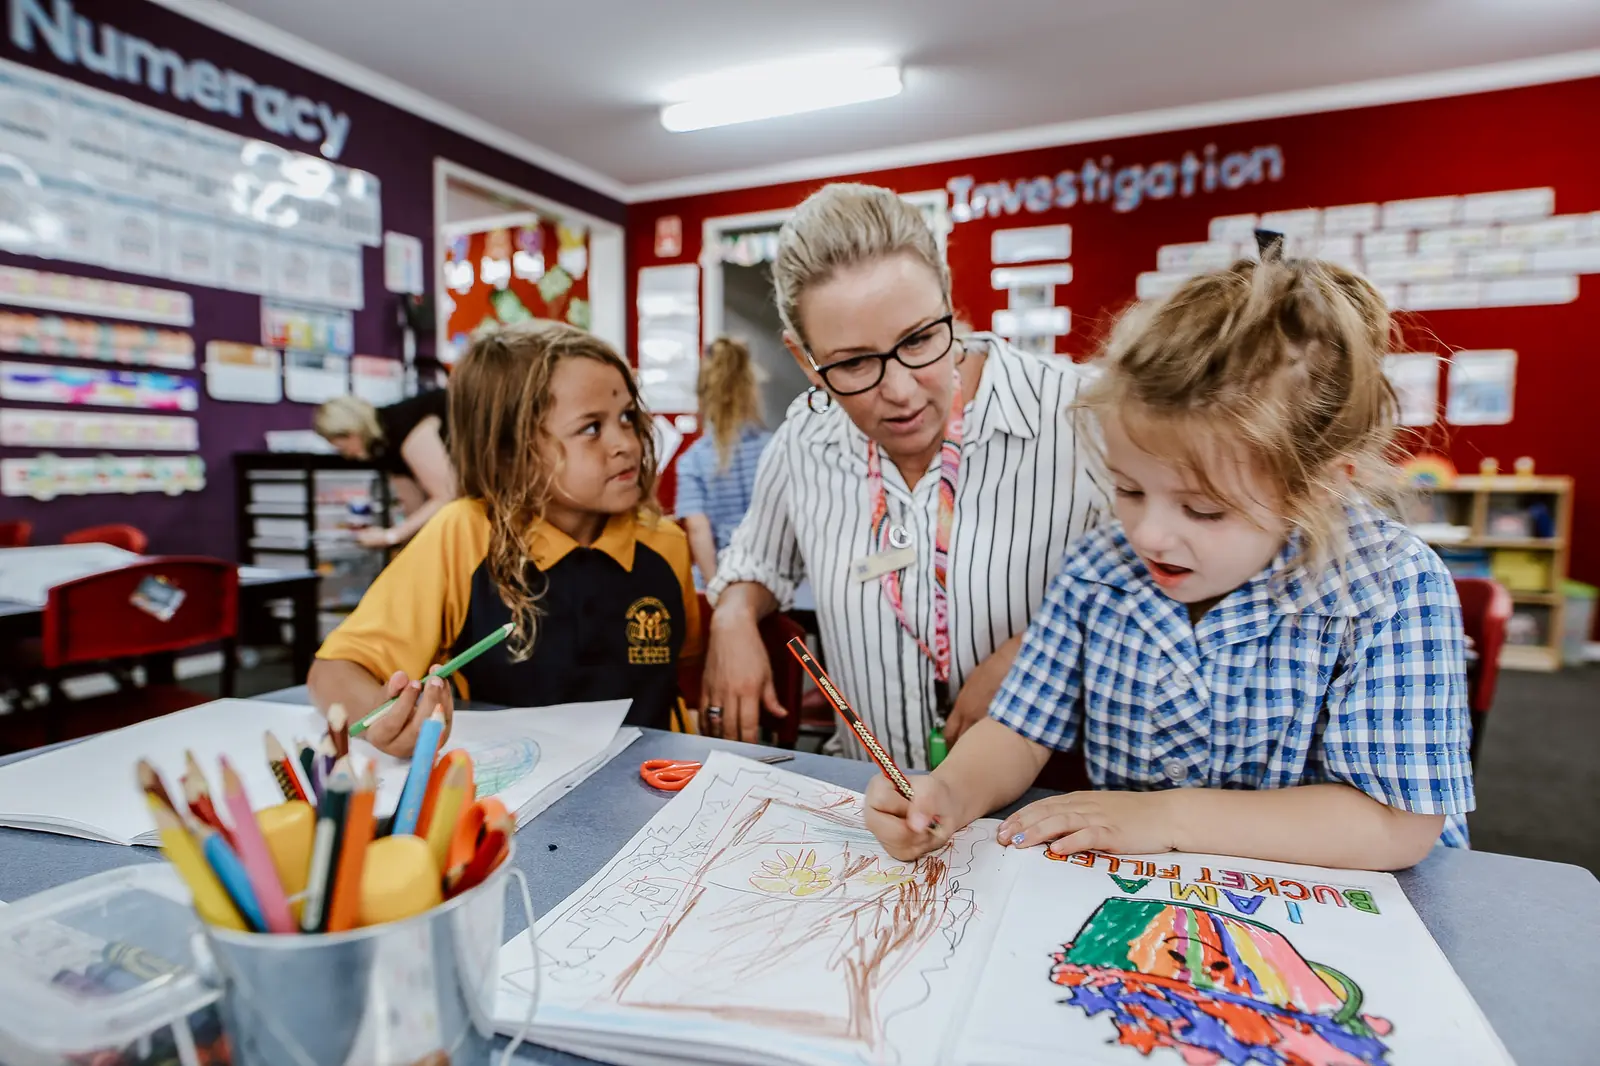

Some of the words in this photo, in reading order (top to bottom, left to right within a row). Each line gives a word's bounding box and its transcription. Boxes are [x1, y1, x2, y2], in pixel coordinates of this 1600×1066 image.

[9, 0, 351, 159] Numeracy
[947, 144, 1284, 220] Investigation
[1107, 872, 1153, 894] A
[1170, 881, 1268, 915] AM
[1194, 867, 1381, 915] BUCKET
[1285, 900, 1303, 924] I
